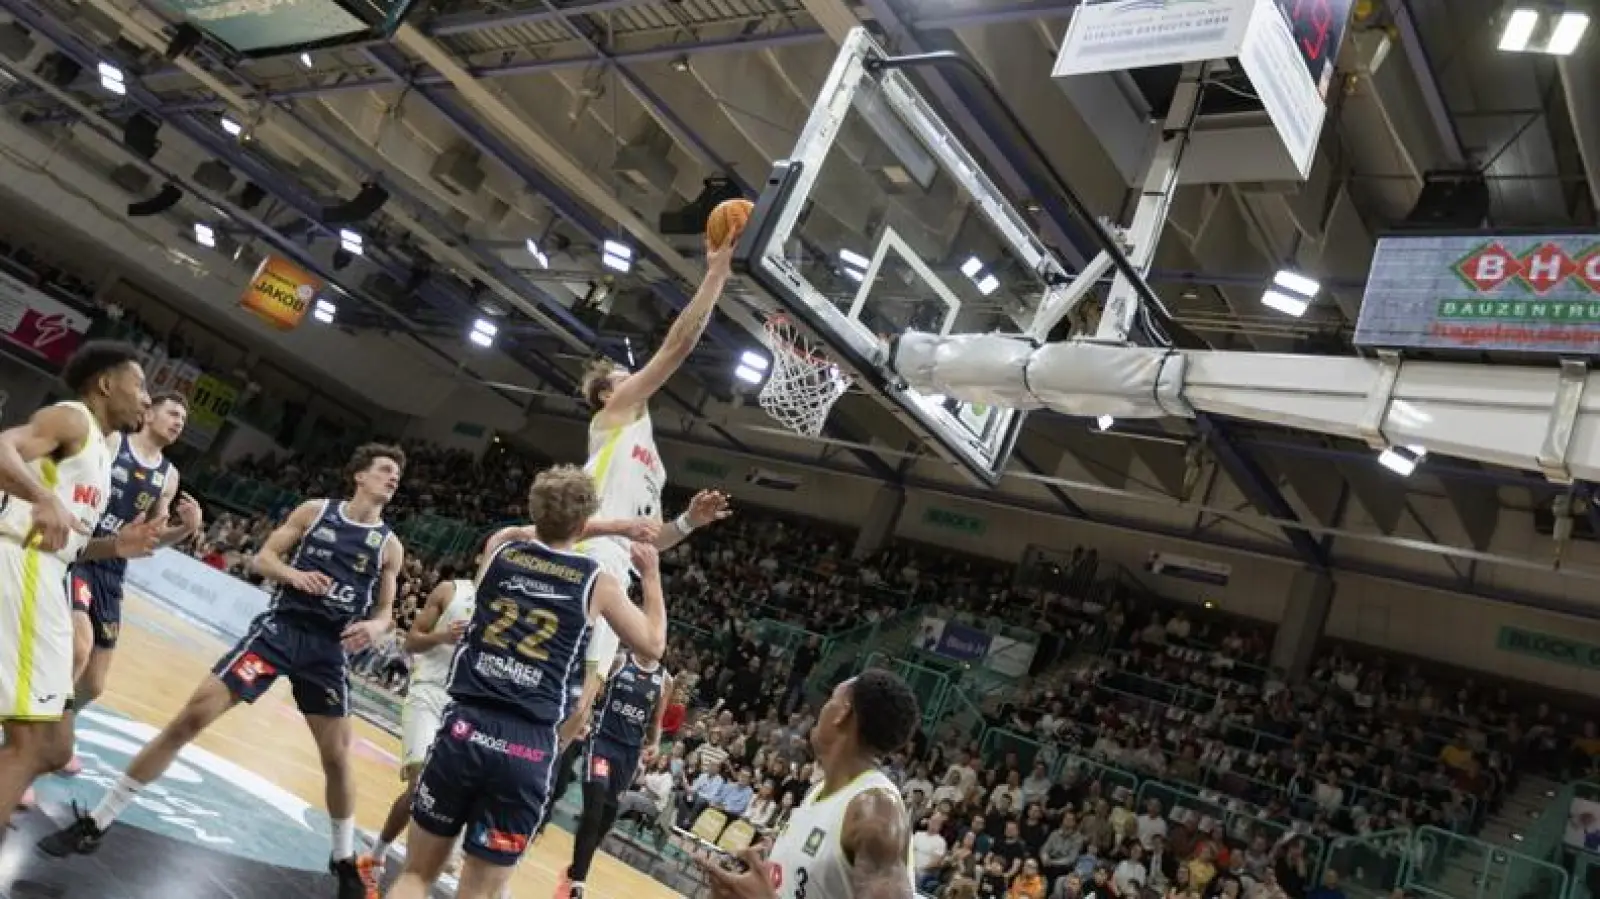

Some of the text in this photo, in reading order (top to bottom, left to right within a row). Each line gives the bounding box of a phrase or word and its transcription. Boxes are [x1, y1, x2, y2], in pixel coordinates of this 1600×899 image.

[353, 553, 369, 572] 3
[326, 582, 357, 602] LG
[482, 598, 559, 661] 22
[1508, 627, 1577, 659] BLOCK
